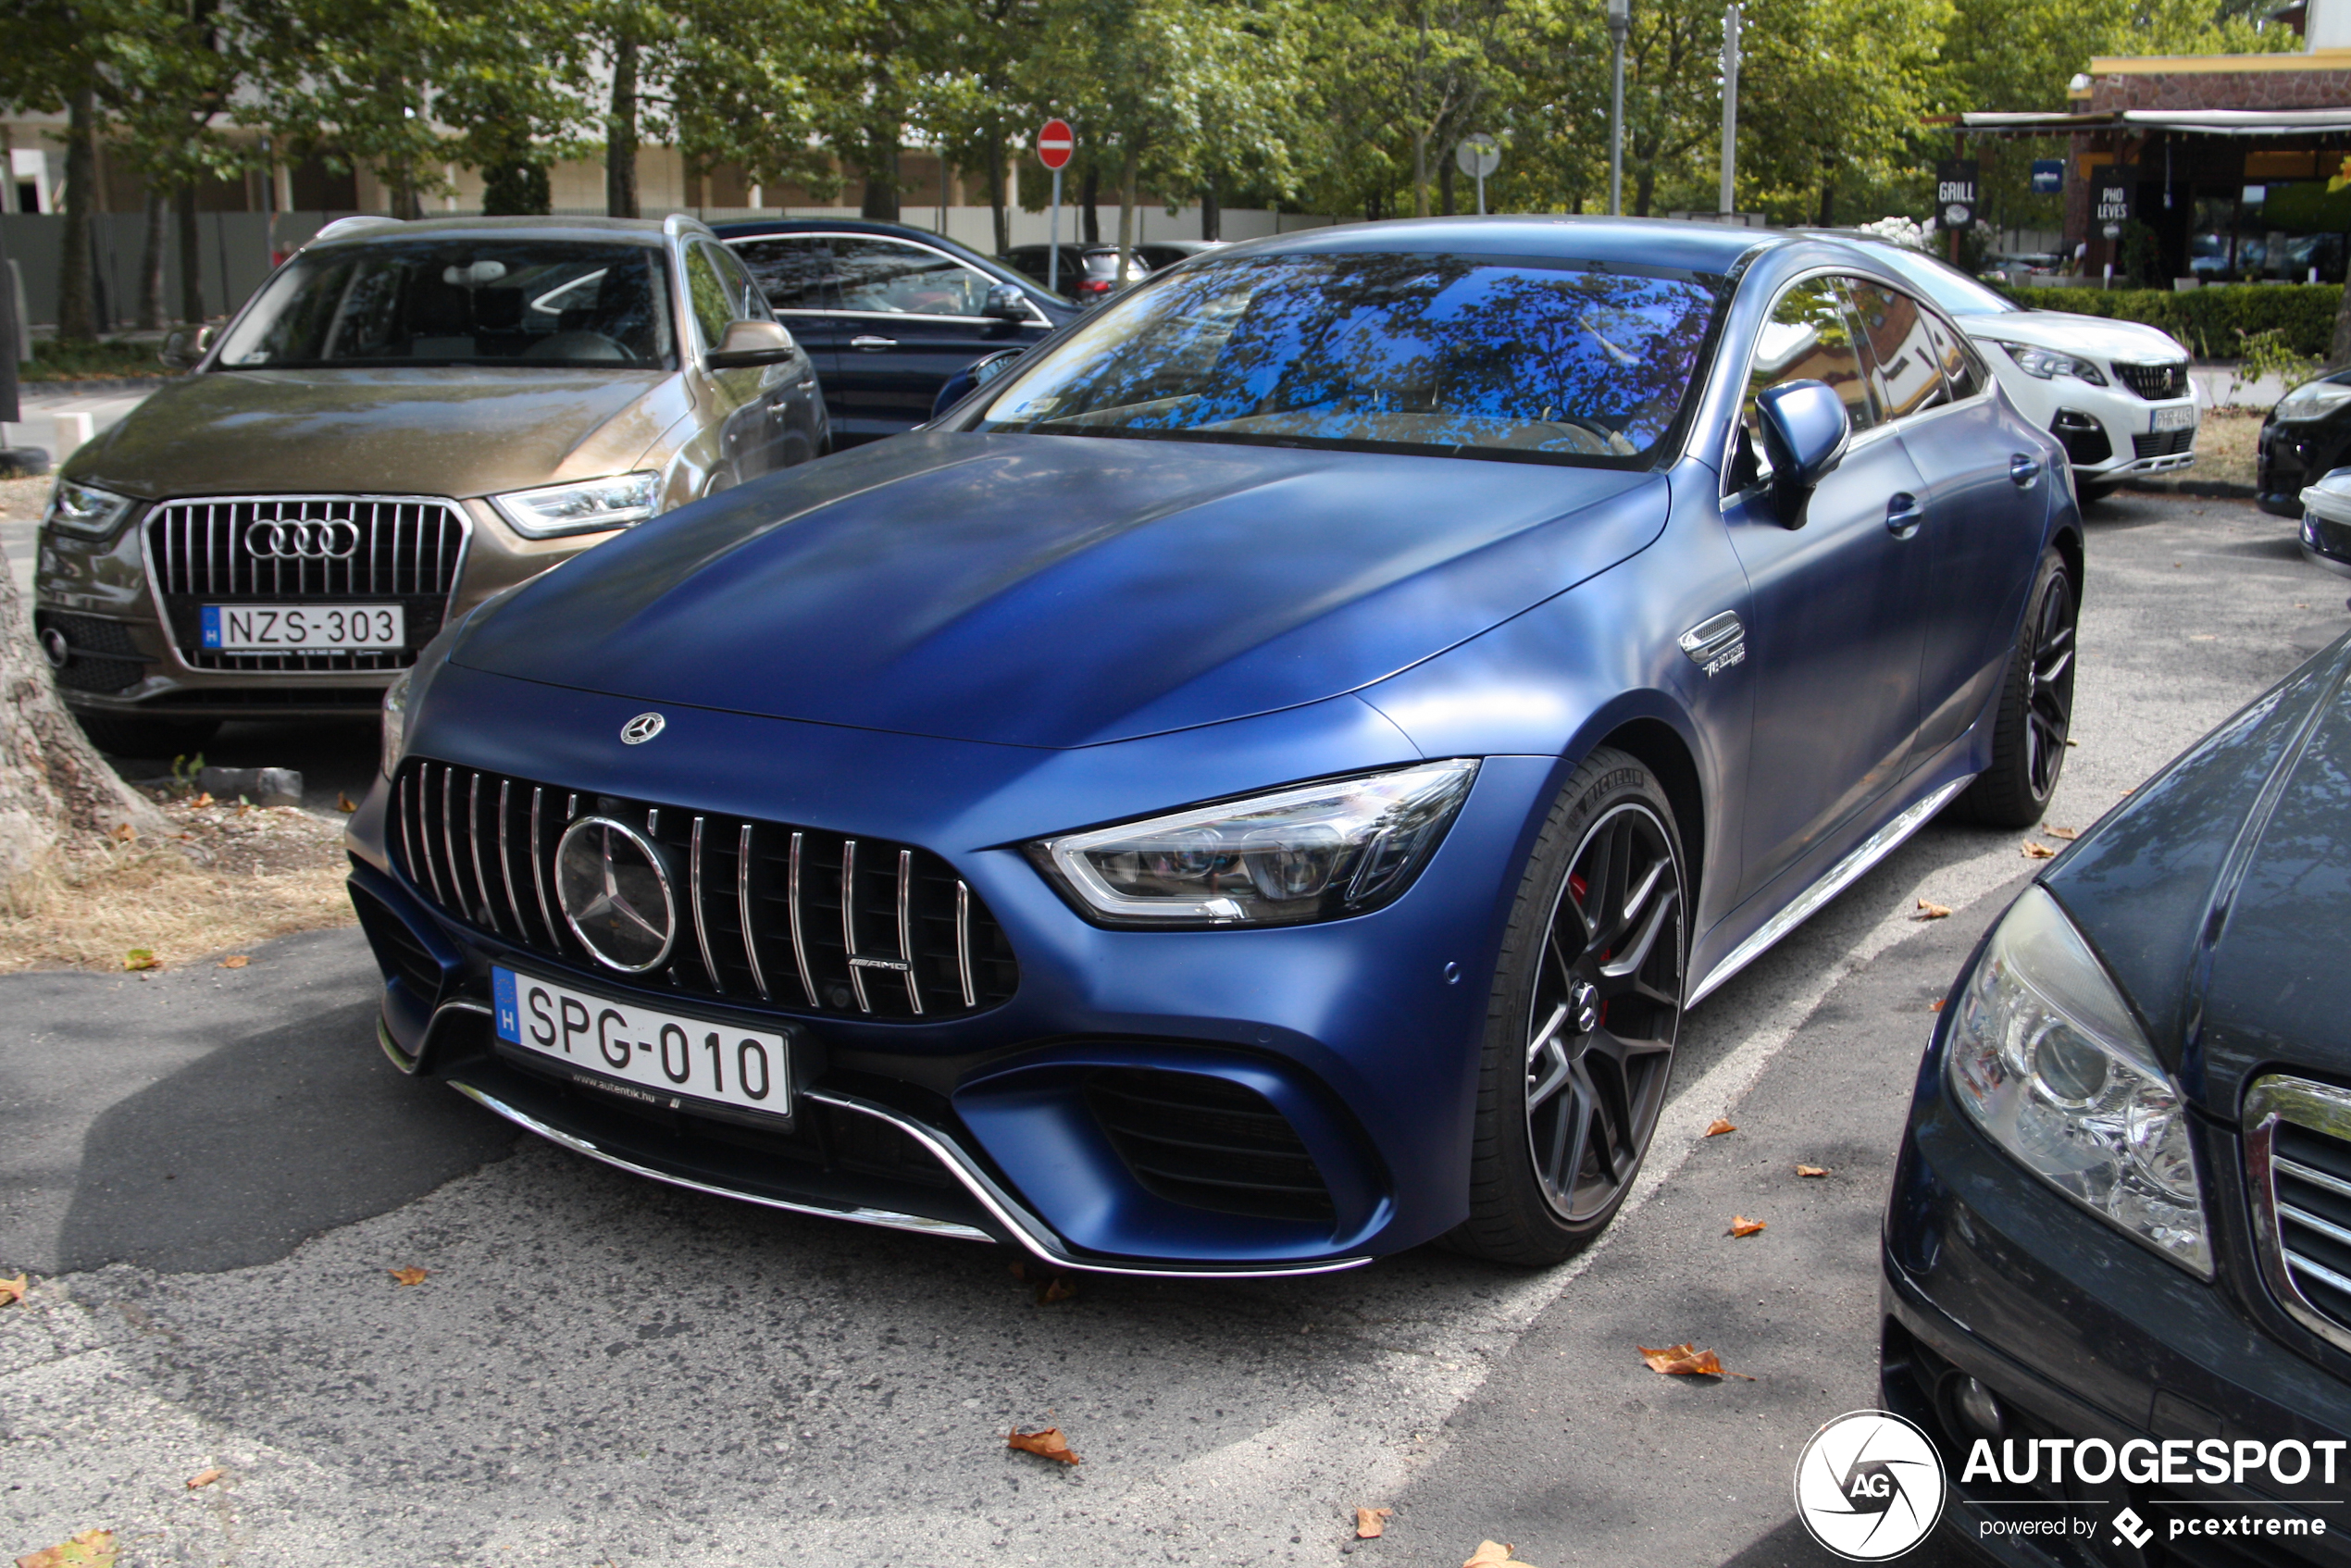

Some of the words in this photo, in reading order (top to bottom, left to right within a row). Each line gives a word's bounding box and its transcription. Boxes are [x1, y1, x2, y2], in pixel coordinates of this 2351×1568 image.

[1938, 181, 1975, 203] GRILL
[2102, 187, 2124, 203] PHO
[2097, 204, 2127, 219] LEVES
[206, 629, 218, 642] H
[229, 610, 393, 642] NZS-303
[1584, 766, 1644, 813] MICHELIN
[866, 960, 908, 971] AMG
[501, 1011, 515, 1031] H
[529, 986, 770, 1101] SPG-010
[572, 1074, 655, 1102] www.autentik.hu
